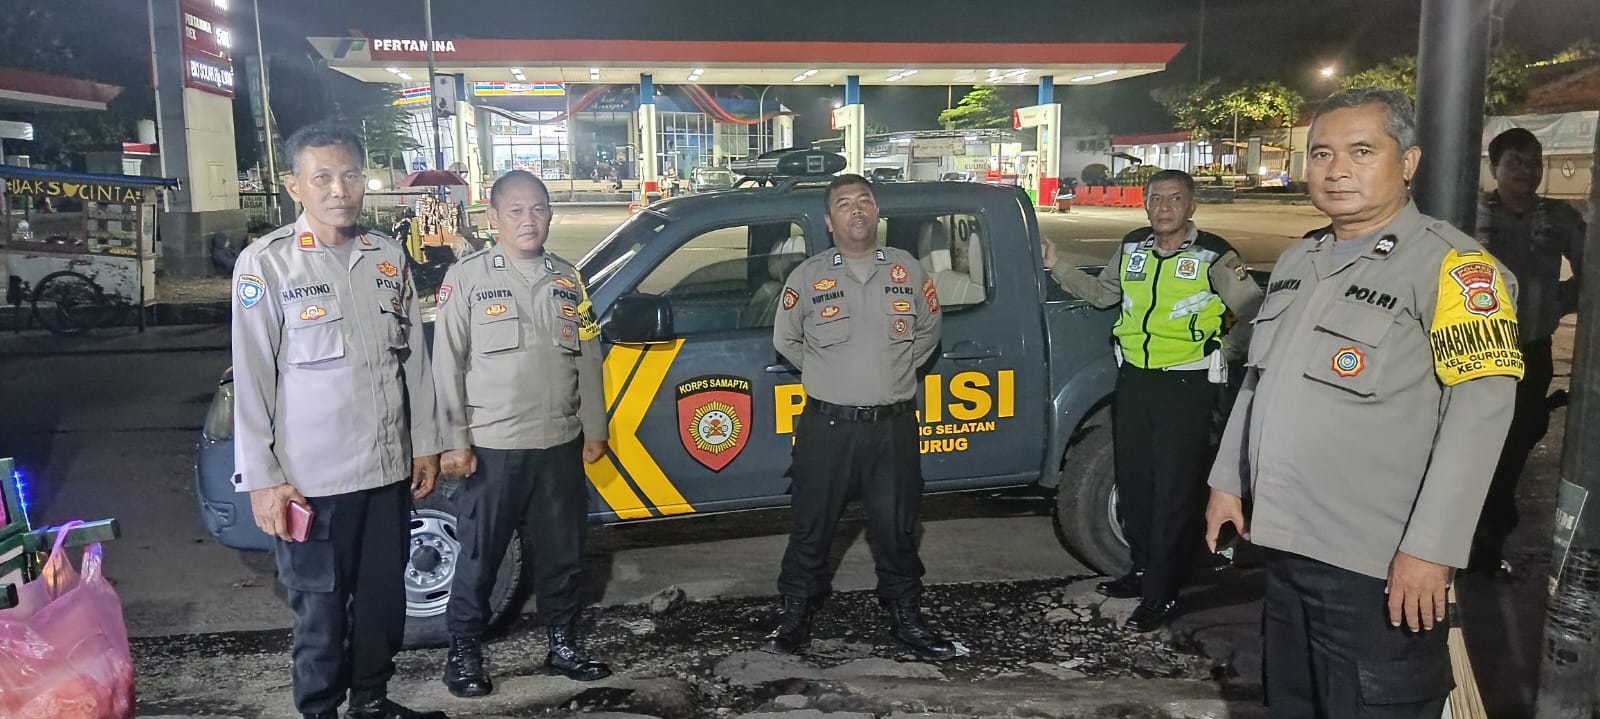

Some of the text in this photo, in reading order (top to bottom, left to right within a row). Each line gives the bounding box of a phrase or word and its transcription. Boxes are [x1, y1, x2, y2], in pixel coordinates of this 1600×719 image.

[374, 39, 456, 52] PERTAMINA
[79, 185, 136, 203] CINTA
[282, 284, 330, 301] HARYONO
[476, 290, 512, 301] SUDIRTA
[886, 286, 913, 295] POLRI
[1345, 284, 1397, 310] POLRI
[1444, 358, 1466, 369] KEL.
[1469, 351, 1508, 361] CURUG
[1457, 361, 1486, 374] KEC.
[679, 378, 749, 394] KORPS SAMAPTA
[774, 369, 1014, 434] PISI
[935, 421, 996, 435] SELATAN
[920, 437, 968, 454] URUG
